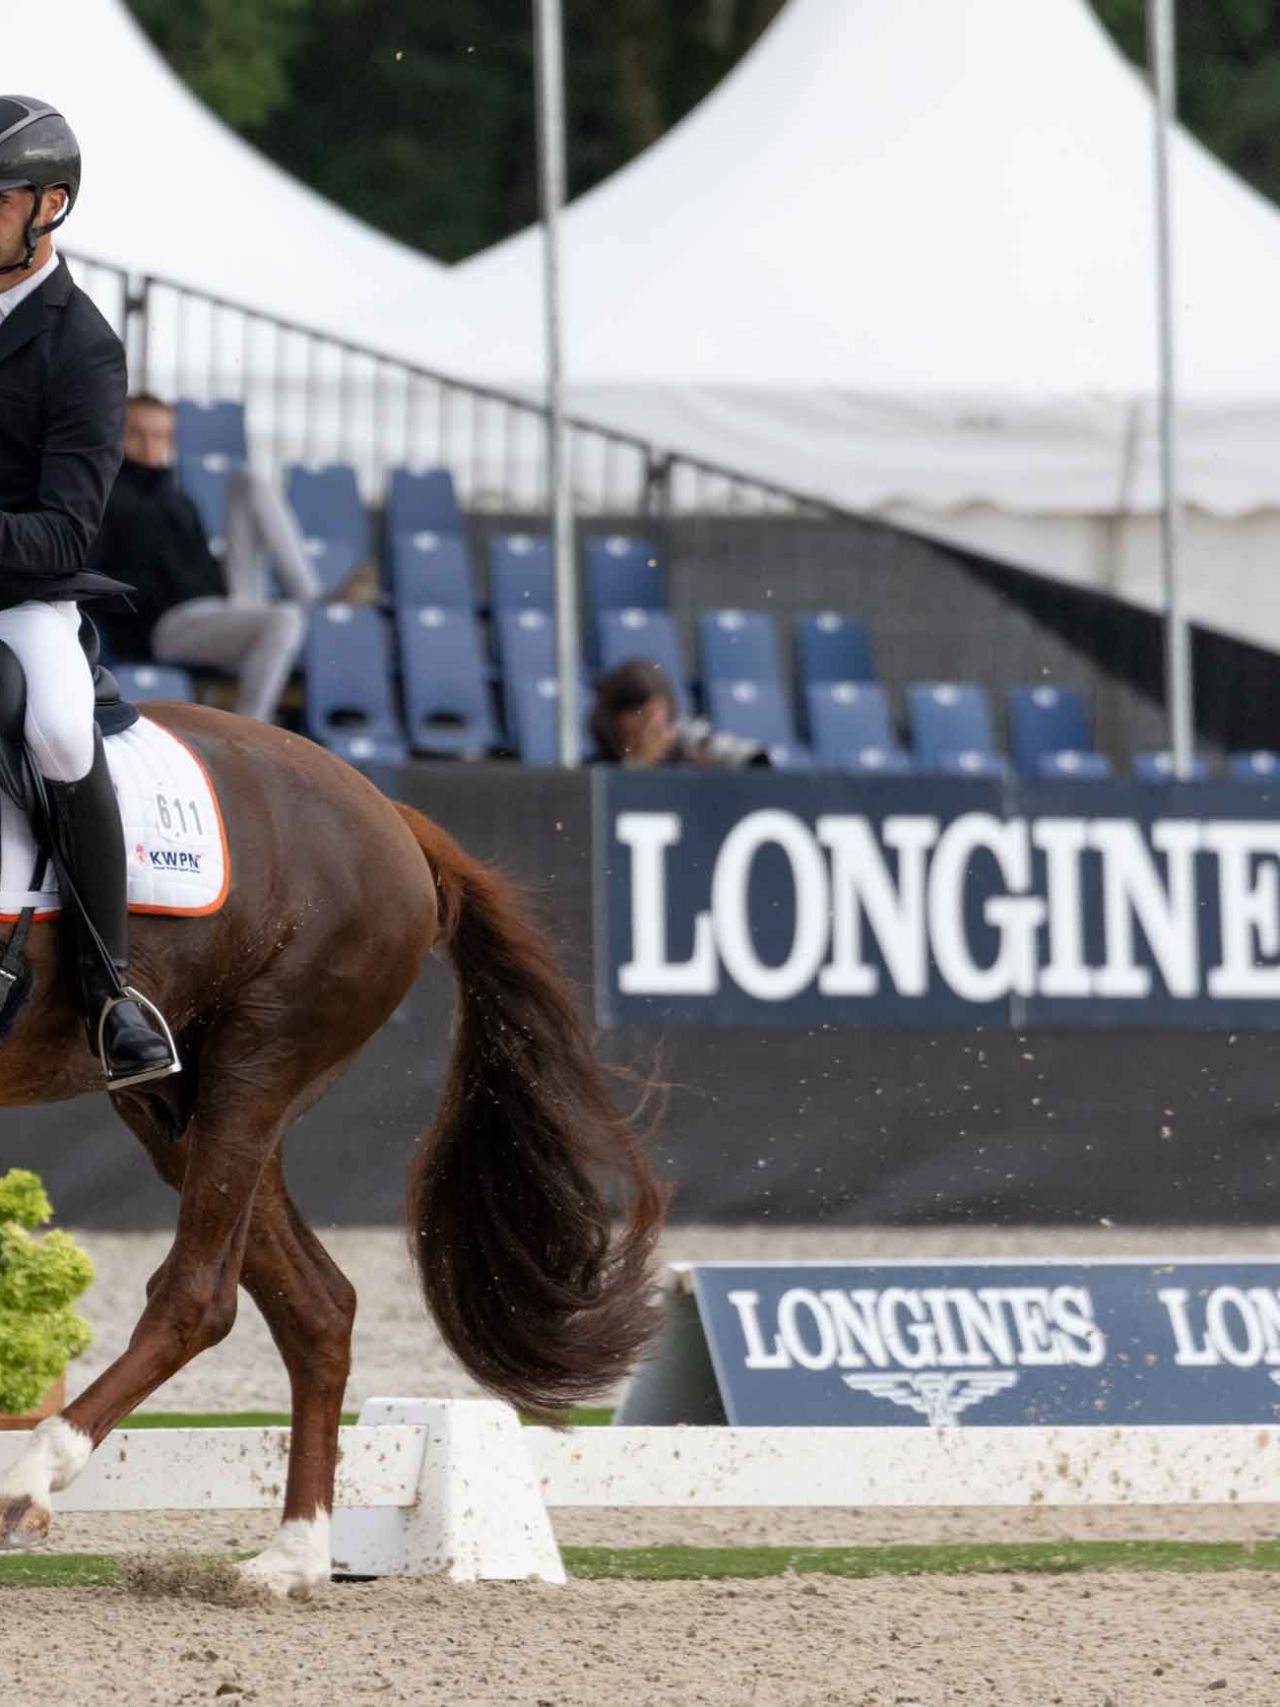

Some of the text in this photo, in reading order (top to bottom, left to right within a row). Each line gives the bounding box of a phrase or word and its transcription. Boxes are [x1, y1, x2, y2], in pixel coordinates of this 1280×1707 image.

[156, 793, 203, 836] 611
[149, 851, 200, 869] KWPN
[727, 1286, 1106, 1371] LONGINES
